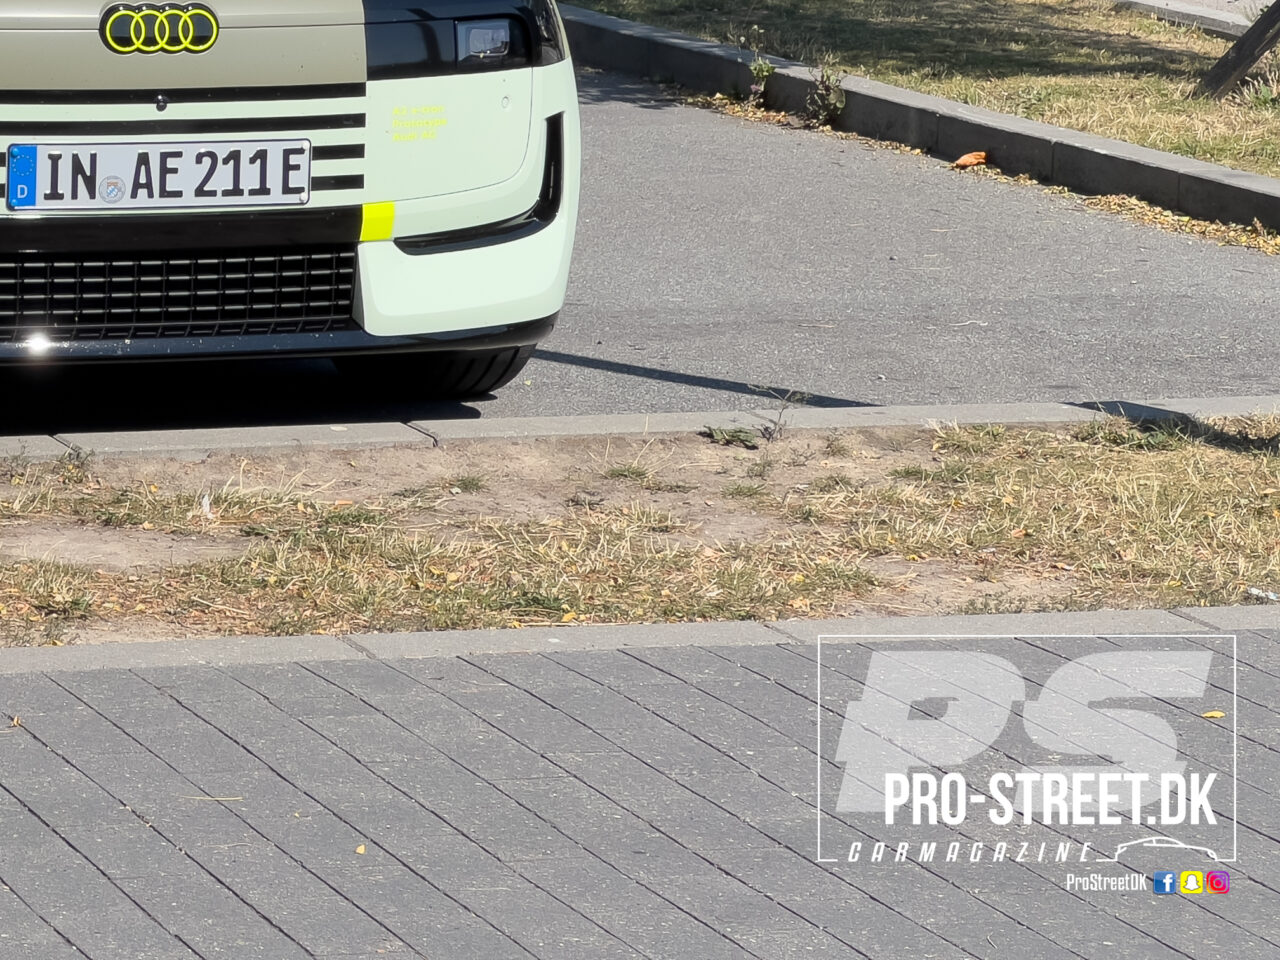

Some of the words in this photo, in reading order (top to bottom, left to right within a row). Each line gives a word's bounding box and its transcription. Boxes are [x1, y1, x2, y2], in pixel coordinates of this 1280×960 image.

[42, 150, 98, 201] IN
[129, 150, 184, 200] AE
[17, 185, 29, 200] D
